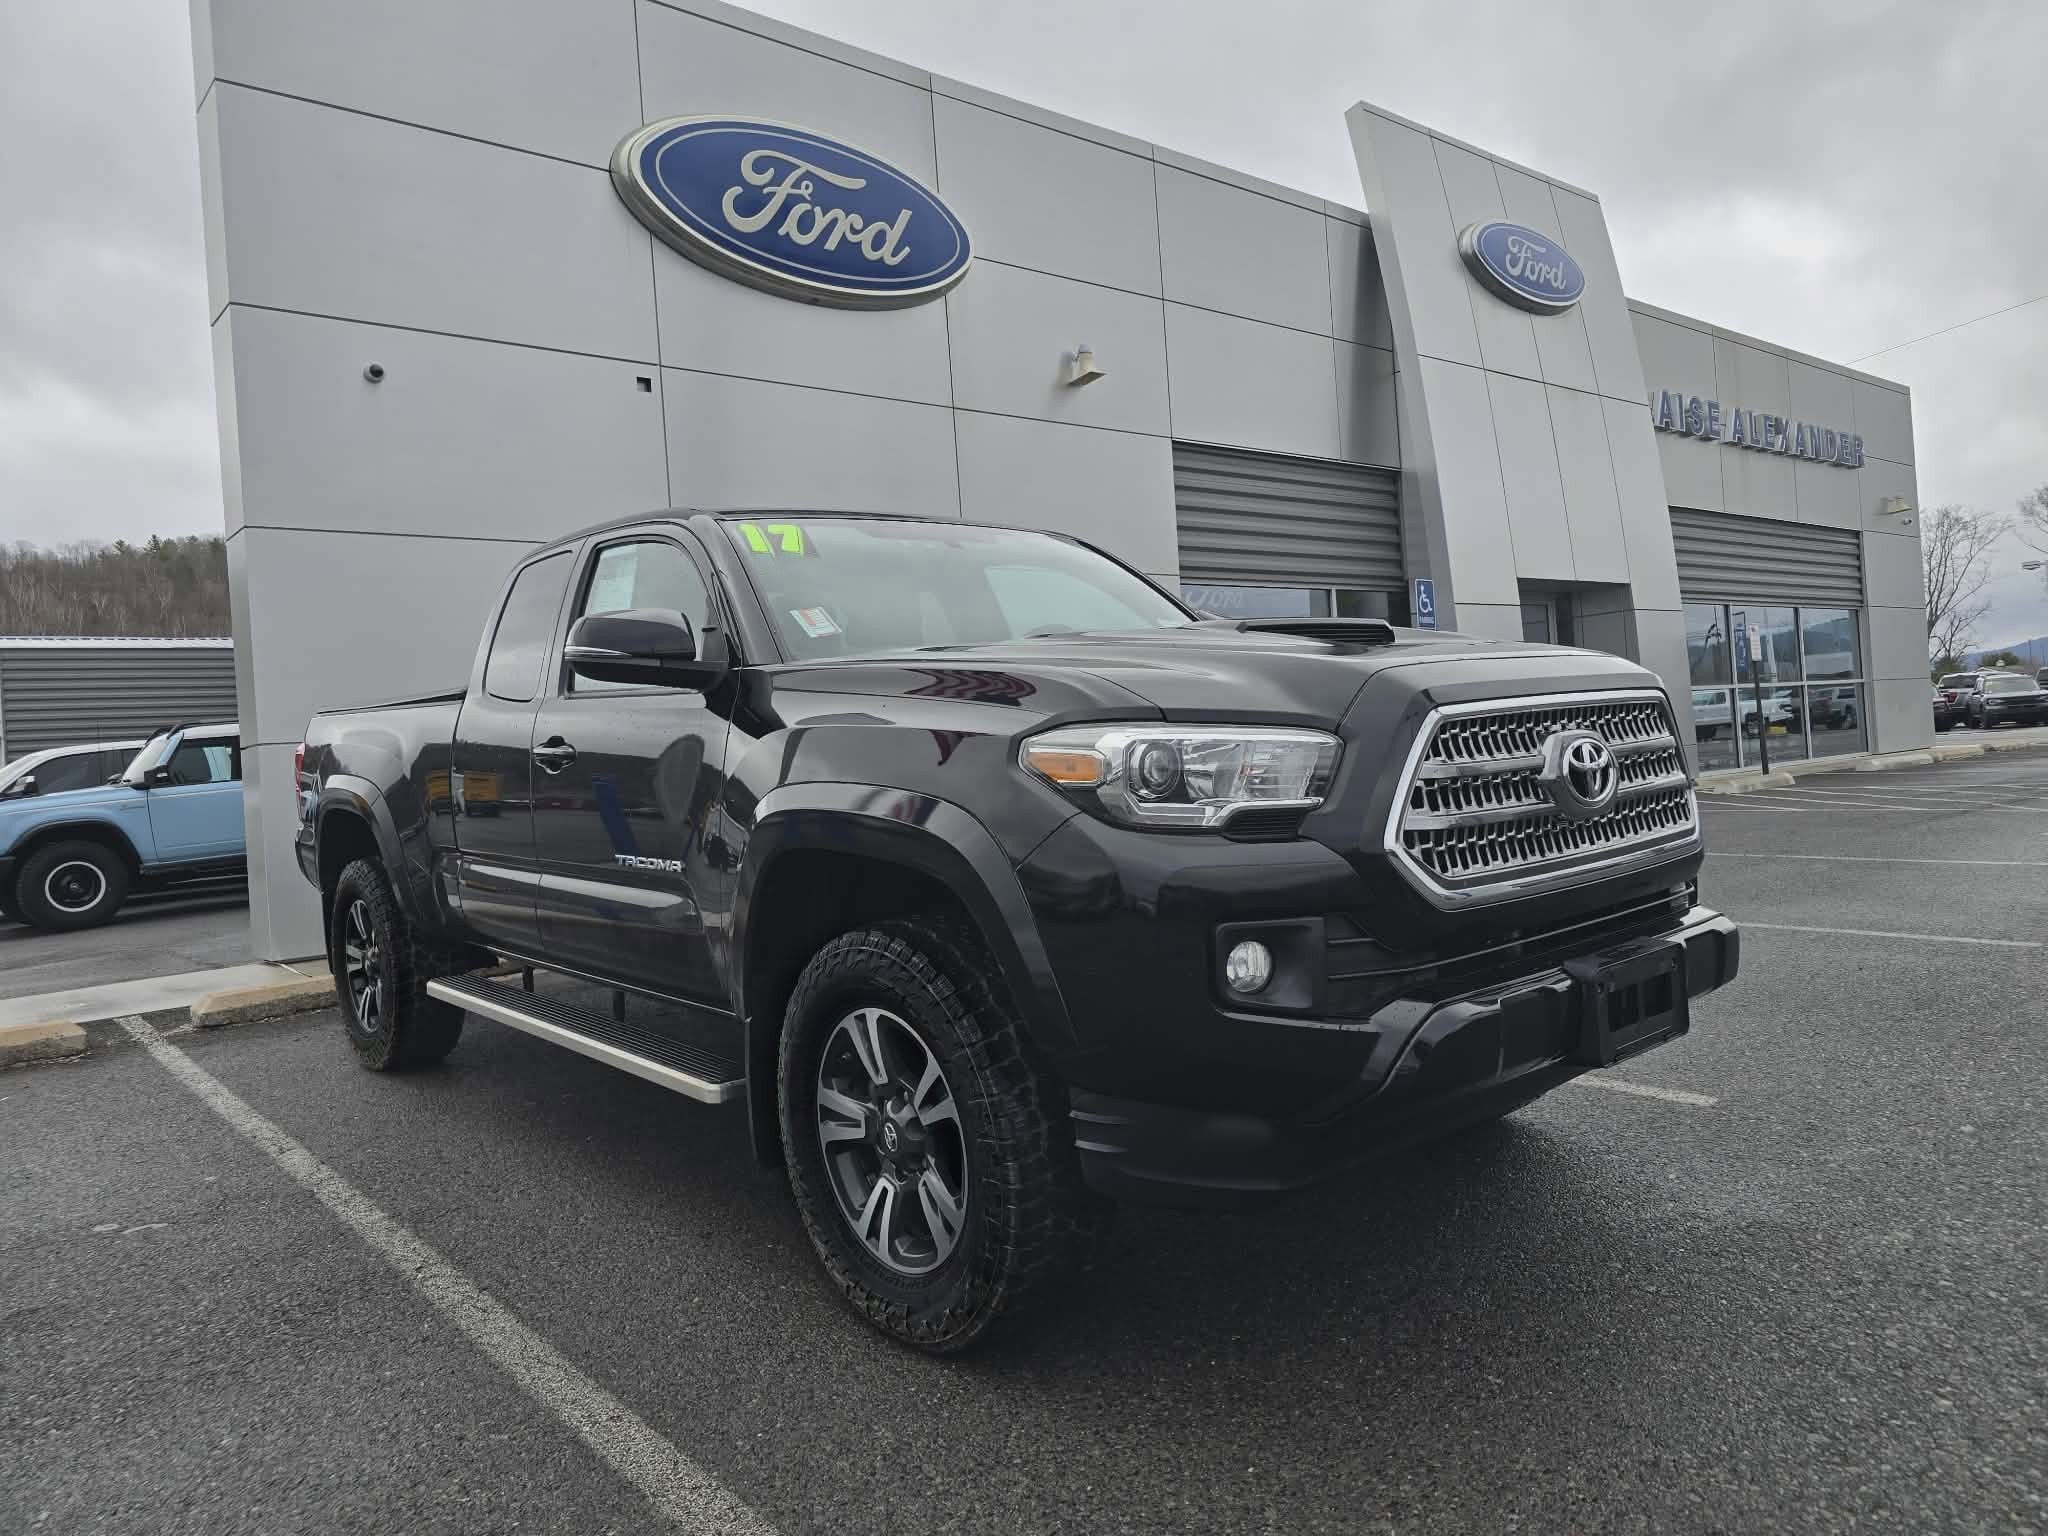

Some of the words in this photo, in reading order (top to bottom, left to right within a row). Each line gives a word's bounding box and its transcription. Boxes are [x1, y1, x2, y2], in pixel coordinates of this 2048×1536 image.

[721, 149, 913, 266] Ford
[1505, 235, 1567, 290] Ford
[1652, 389, 1721, 440] AISE
[1729, 406, 1865, 467] ALEXANDER
[737, 523, 804, 558] 17
[614, 854, 683, 873] TACOMA
